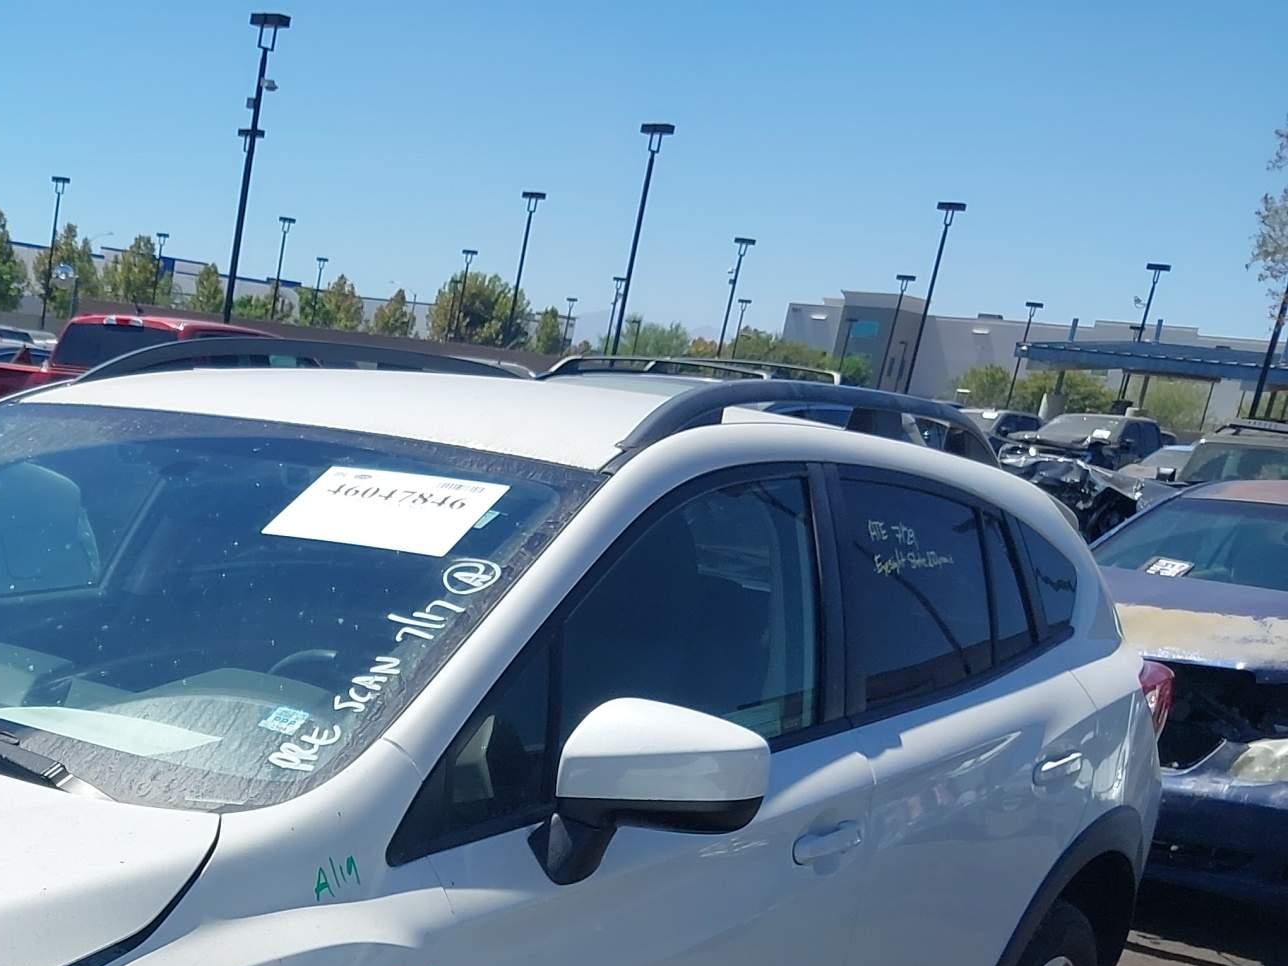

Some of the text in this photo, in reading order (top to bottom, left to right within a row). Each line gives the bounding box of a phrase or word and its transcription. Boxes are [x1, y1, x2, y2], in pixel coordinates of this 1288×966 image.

[327, 483, 467, 510] 46047846
[268, 724, 341, 772] PRE
[334, 656, 401, 713] SCAN
